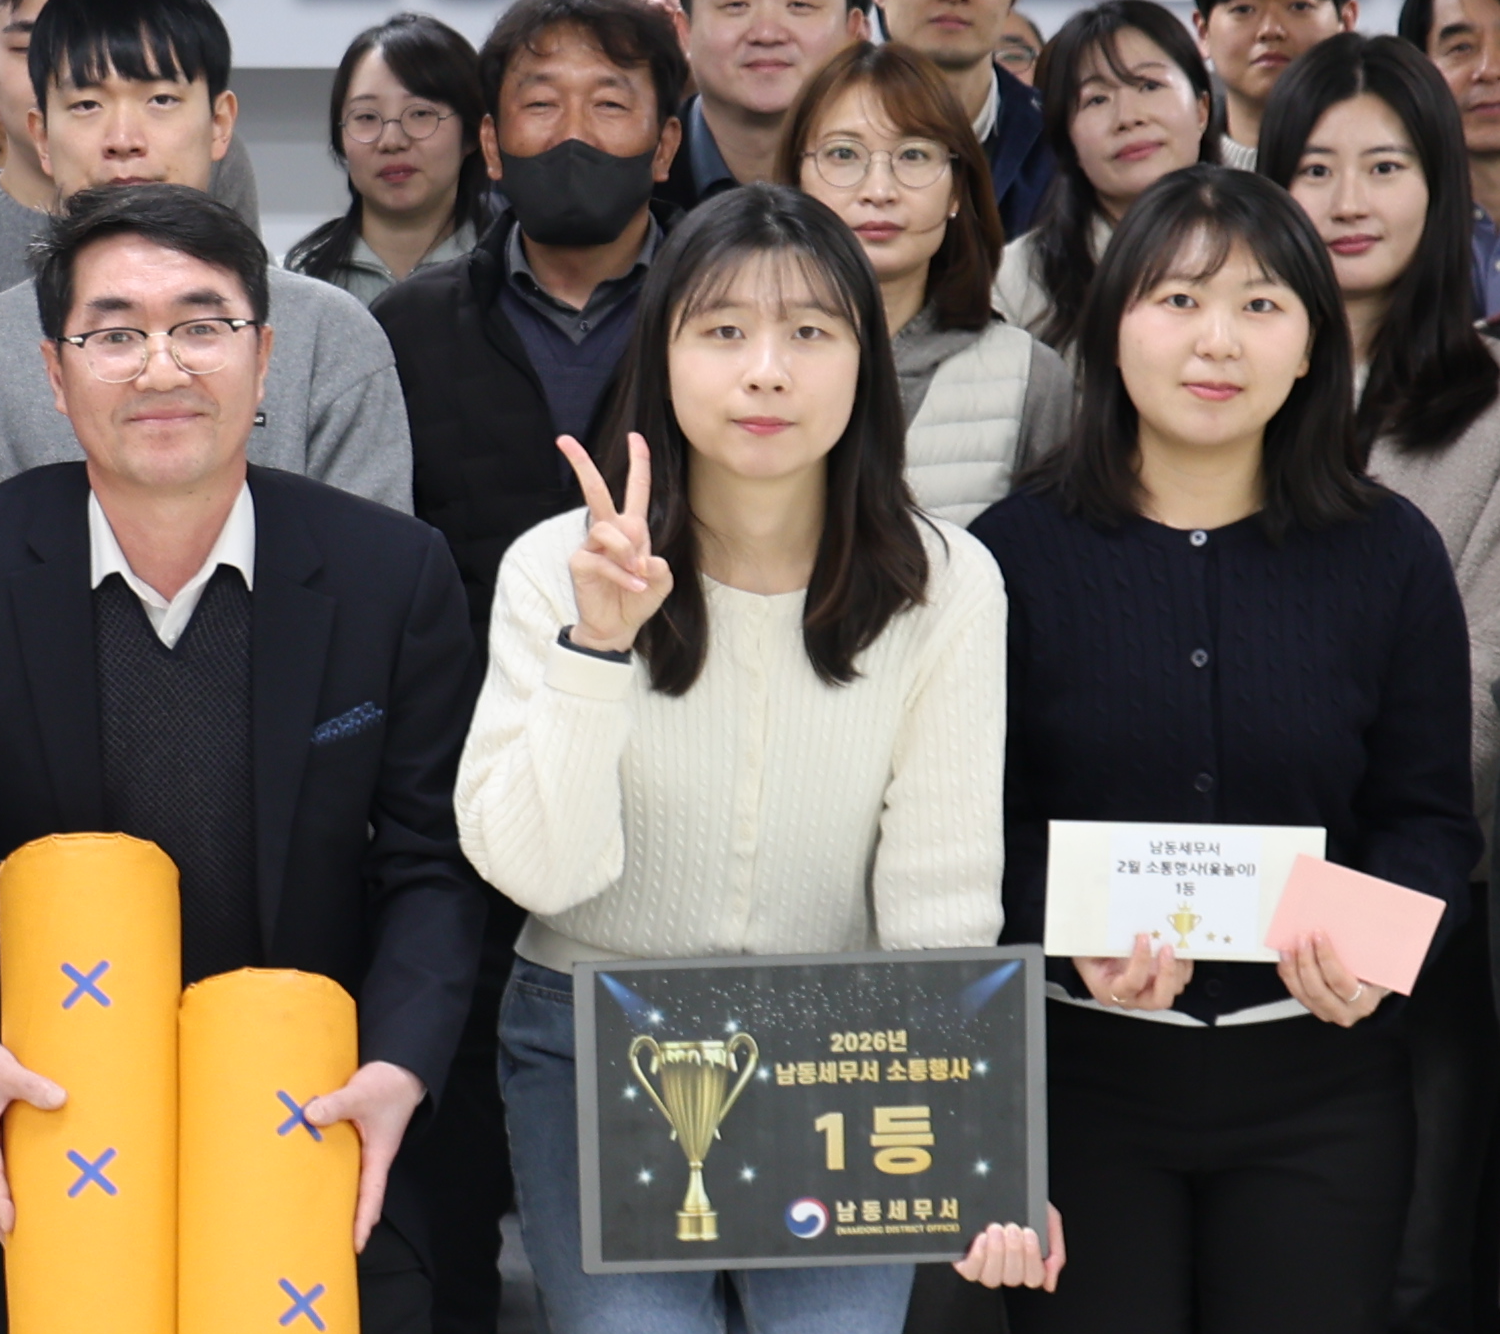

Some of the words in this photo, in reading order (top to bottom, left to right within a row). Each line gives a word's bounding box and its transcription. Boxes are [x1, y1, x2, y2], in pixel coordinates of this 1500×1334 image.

[1149, 840, 1221, 856] 남동세무서
[1117, 860, 1141, 875] 2월
[1175, 882, 1196, 896] 1등
[829, 1028, 908, 1054] 2026년
[774, 1059, 880, 1086] 남동세무서
[886, 1056, 972, 1082] 소통행사
[835, 1197, 960, 1223] 남동세무서
